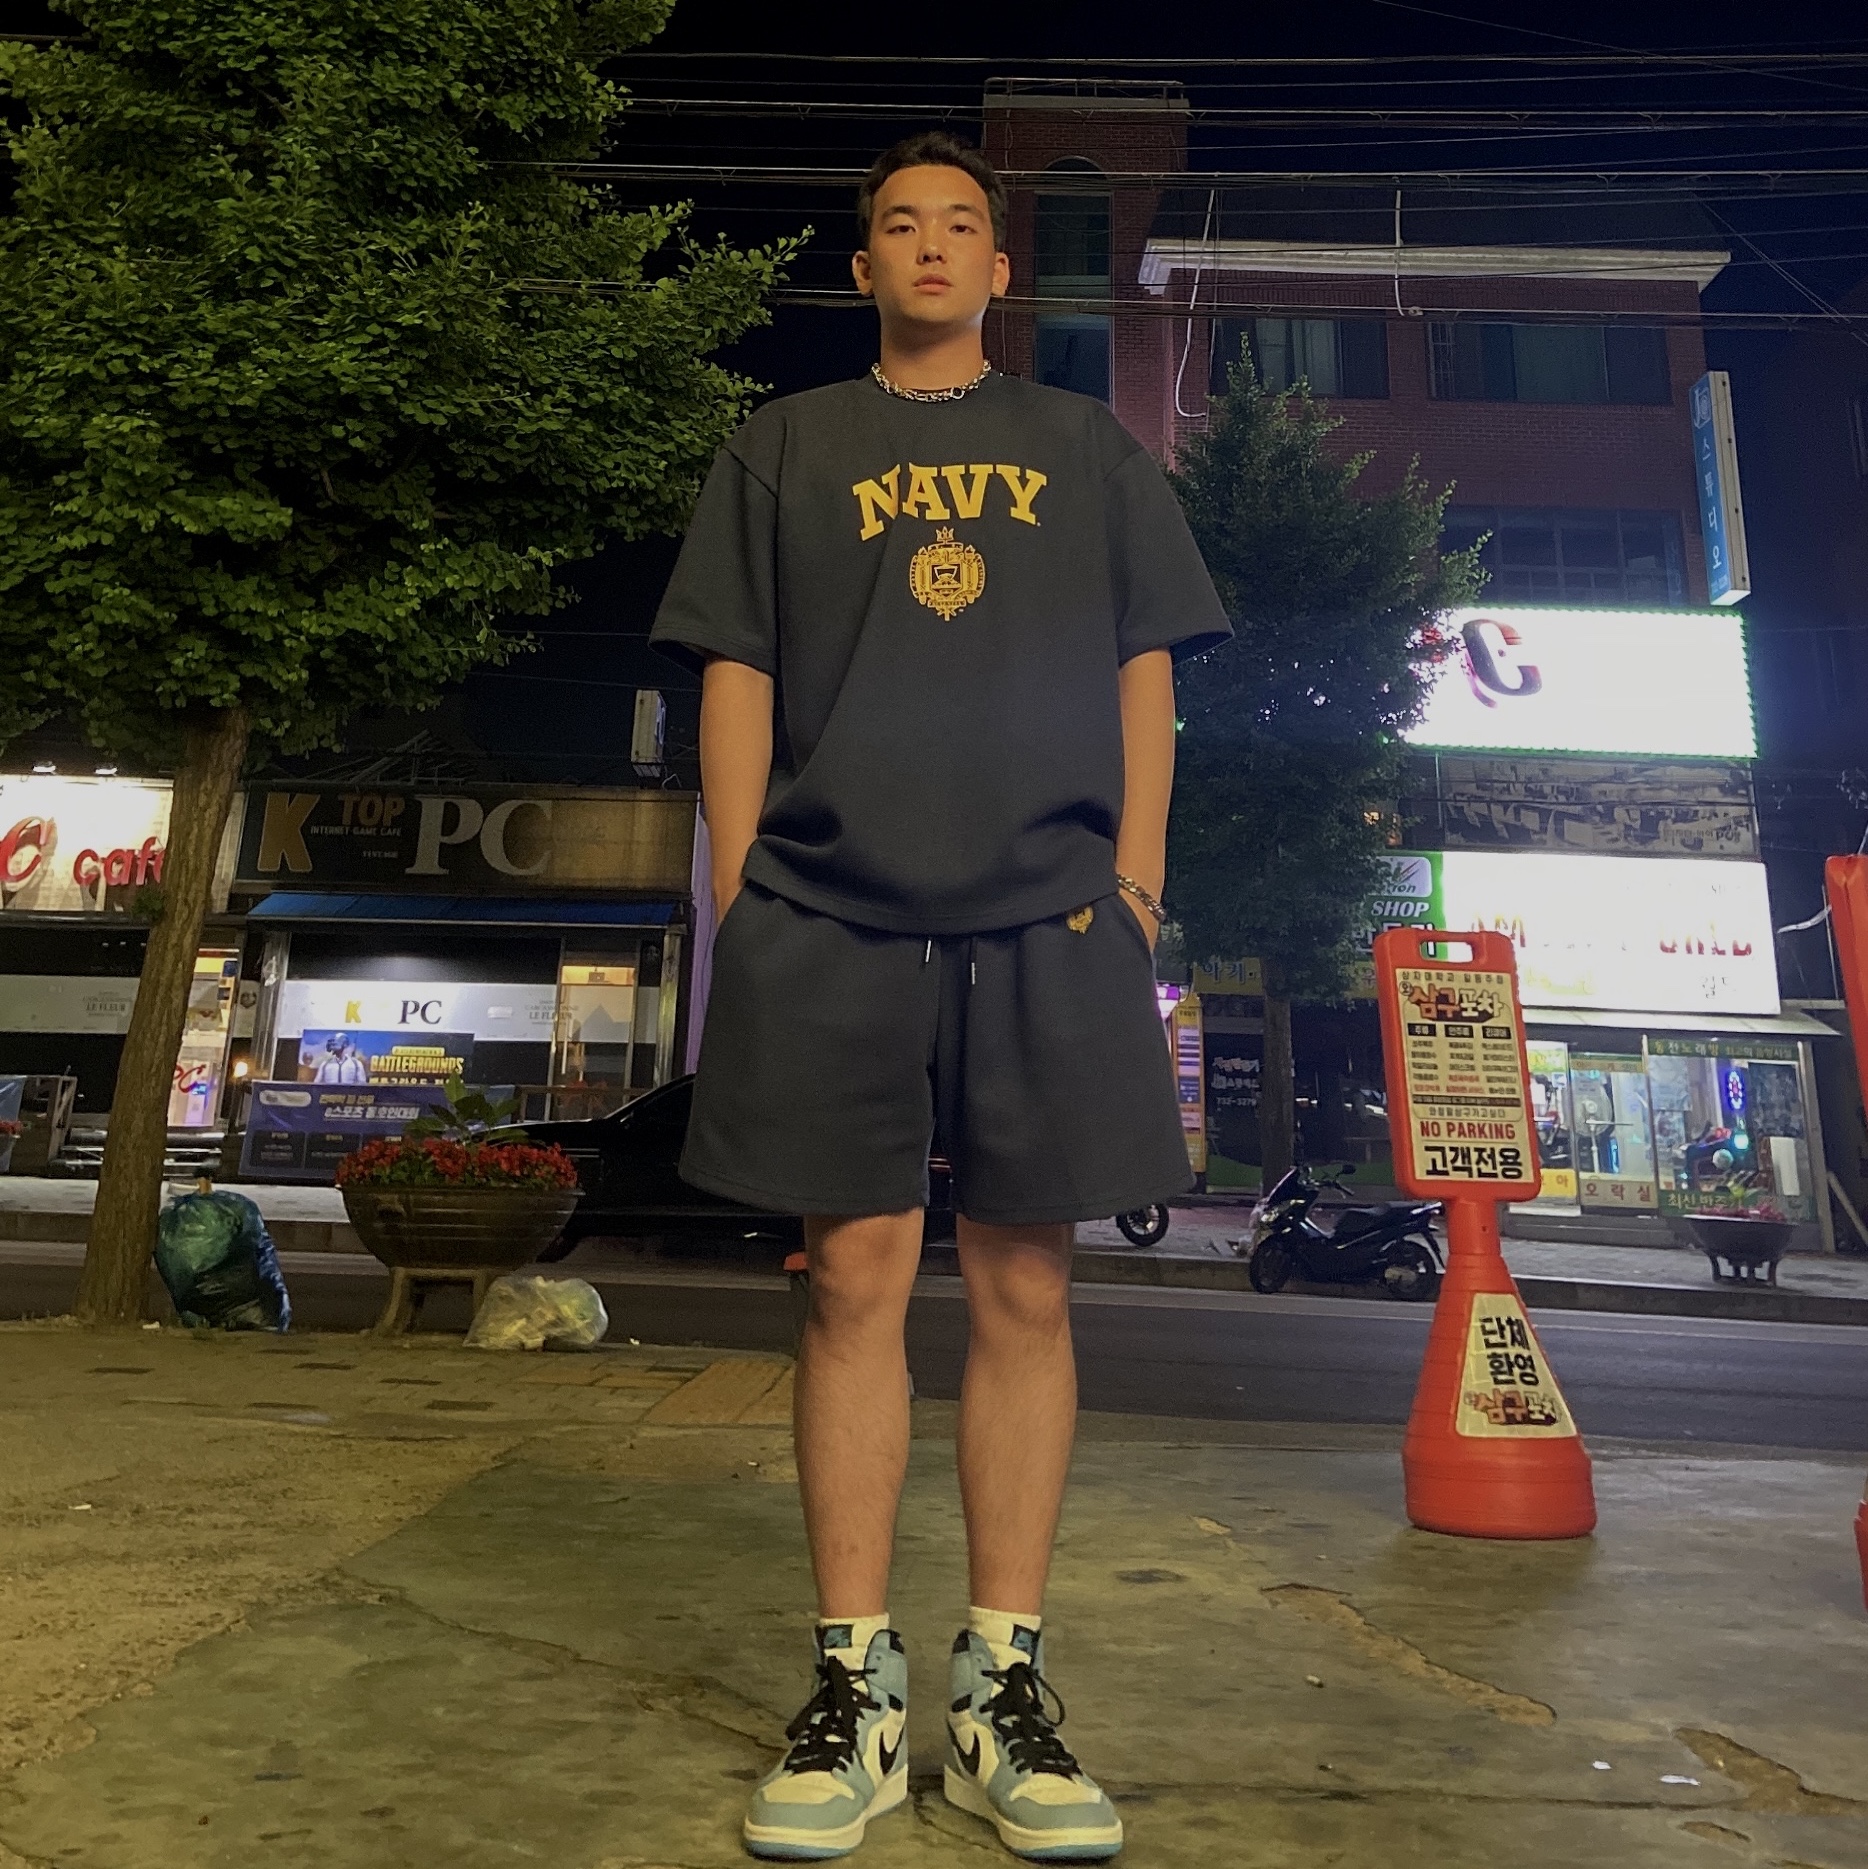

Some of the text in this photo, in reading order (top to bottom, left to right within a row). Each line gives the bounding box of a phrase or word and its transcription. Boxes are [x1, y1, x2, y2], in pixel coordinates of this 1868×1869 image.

[852, 462, 1047, 541] NAVY
[1702, 437, 1722, 570] 스튜디오
[338, 793, 405, 827] TOP
[257, 792, 320, 872] K
[352, 827, 377, 836] GAME
[405, 796, 553, 876] PC
[1371, 901, 1430, 918] SHOP
[345, 1000, 442, 1025] K PC
[1408, 983, 1505, 1018] 삼구포차
[370, 1055, 464, 1074] BATTLEGROUNDS
[1420, 1121, 1516, 1140] NO PARKING
[1424, 1145, 1523, 1179] 고객전용
[1585, 1182, 1650, 1202] 오락실
[1668, 1193, 1696, 1210] 최신
[1479, 1315, 1531, 1351] 단체
[1487, 1352, 1540, 1386] 환영
